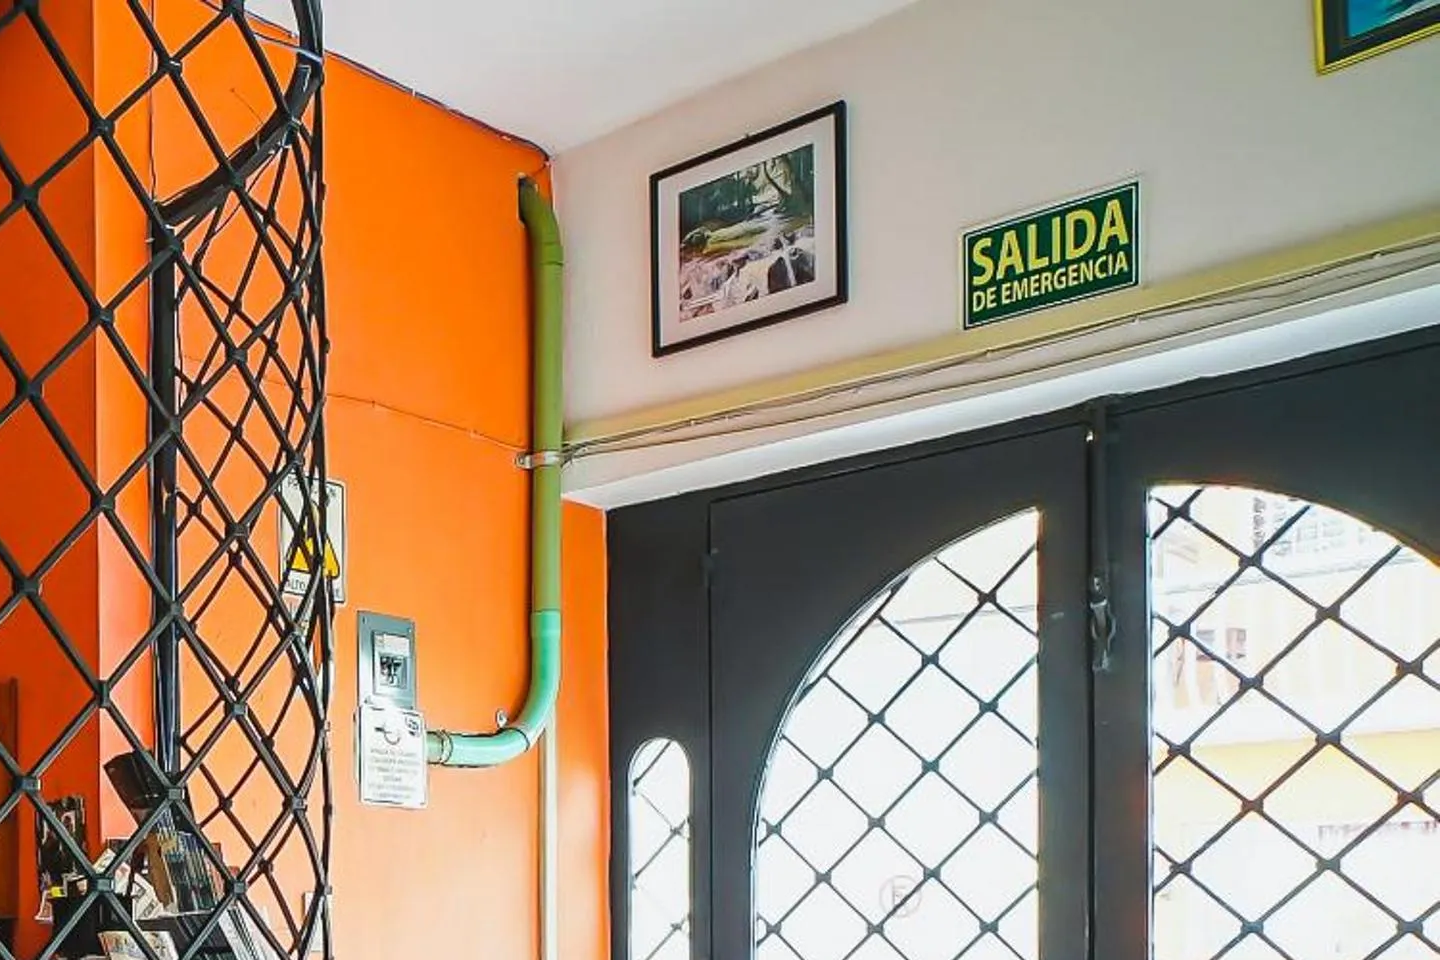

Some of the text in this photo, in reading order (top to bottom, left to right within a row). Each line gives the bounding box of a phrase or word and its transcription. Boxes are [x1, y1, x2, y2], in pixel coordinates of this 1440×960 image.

[971, 198, 1130, 287] SALIDA
[972, 250, 1129, 313] DE EMERGENCIA
